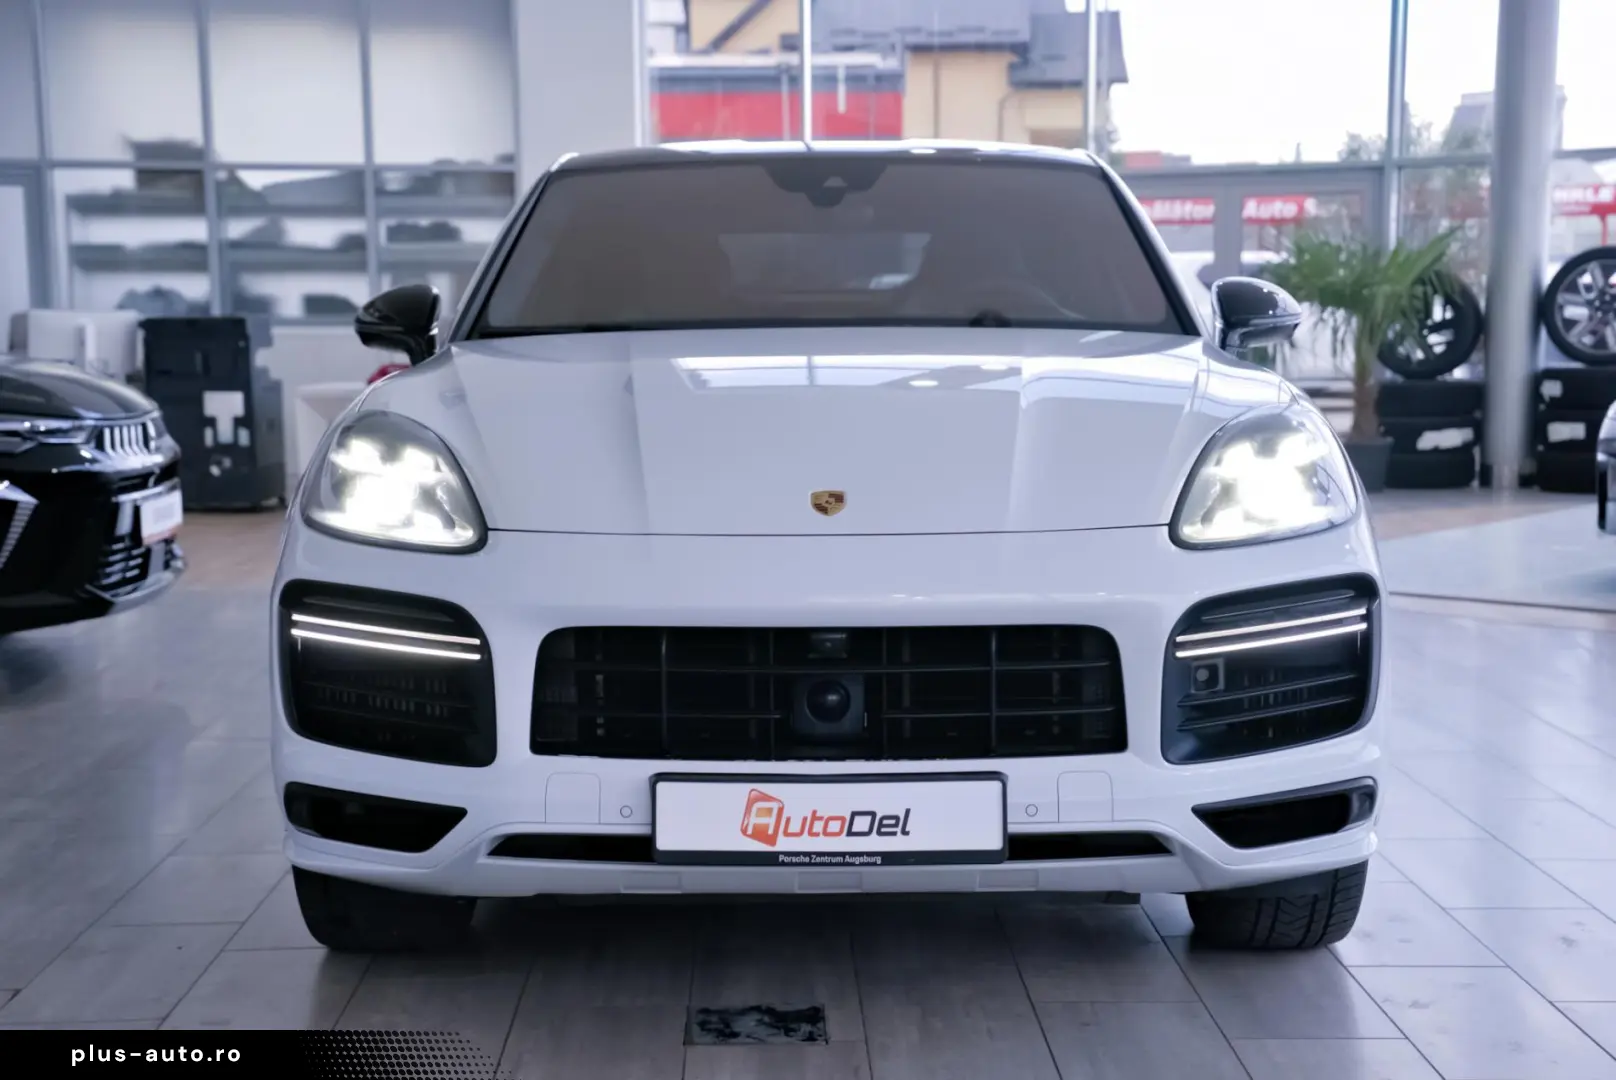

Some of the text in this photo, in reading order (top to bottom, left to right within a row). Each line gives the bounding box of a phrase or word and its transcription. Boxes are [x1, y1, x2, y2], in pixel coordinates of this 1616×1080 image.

[1241, 197, 1299, 220] Auto
[744, 797, 911, 840] AutoDel
[778, 854, 882, 865] Porsche Zentrum Augsburg
